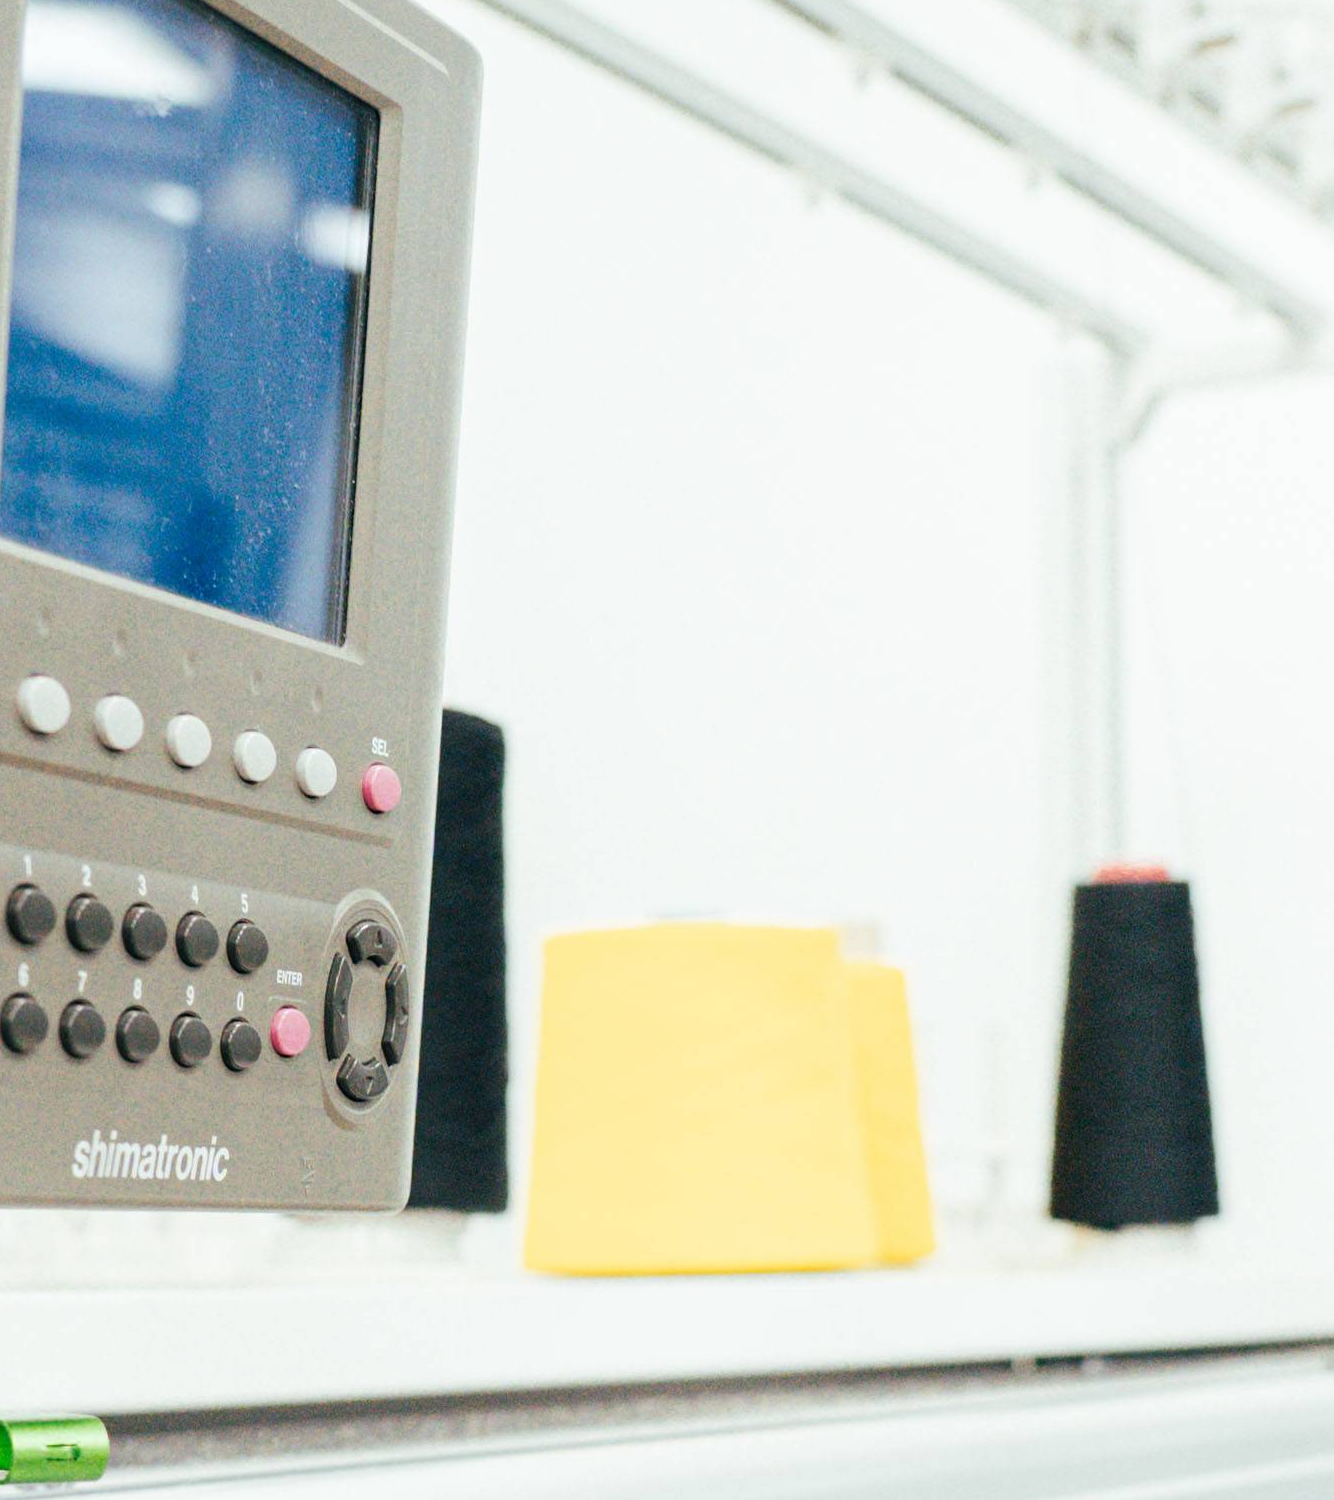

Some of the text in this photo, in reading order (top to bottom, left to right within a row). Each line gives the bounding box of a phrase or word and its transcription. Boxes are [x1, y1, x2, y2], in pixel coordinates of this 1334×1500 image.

[371, 736, 389, 757] SEL
[23, 853, 249, 914] 1 2 3 4 5
[18, 962, 245, 1012] 6 7 8 9 0
[276, 969, 303, 987] ENTER
[71, 1129, 230, 1182] shimatronic
